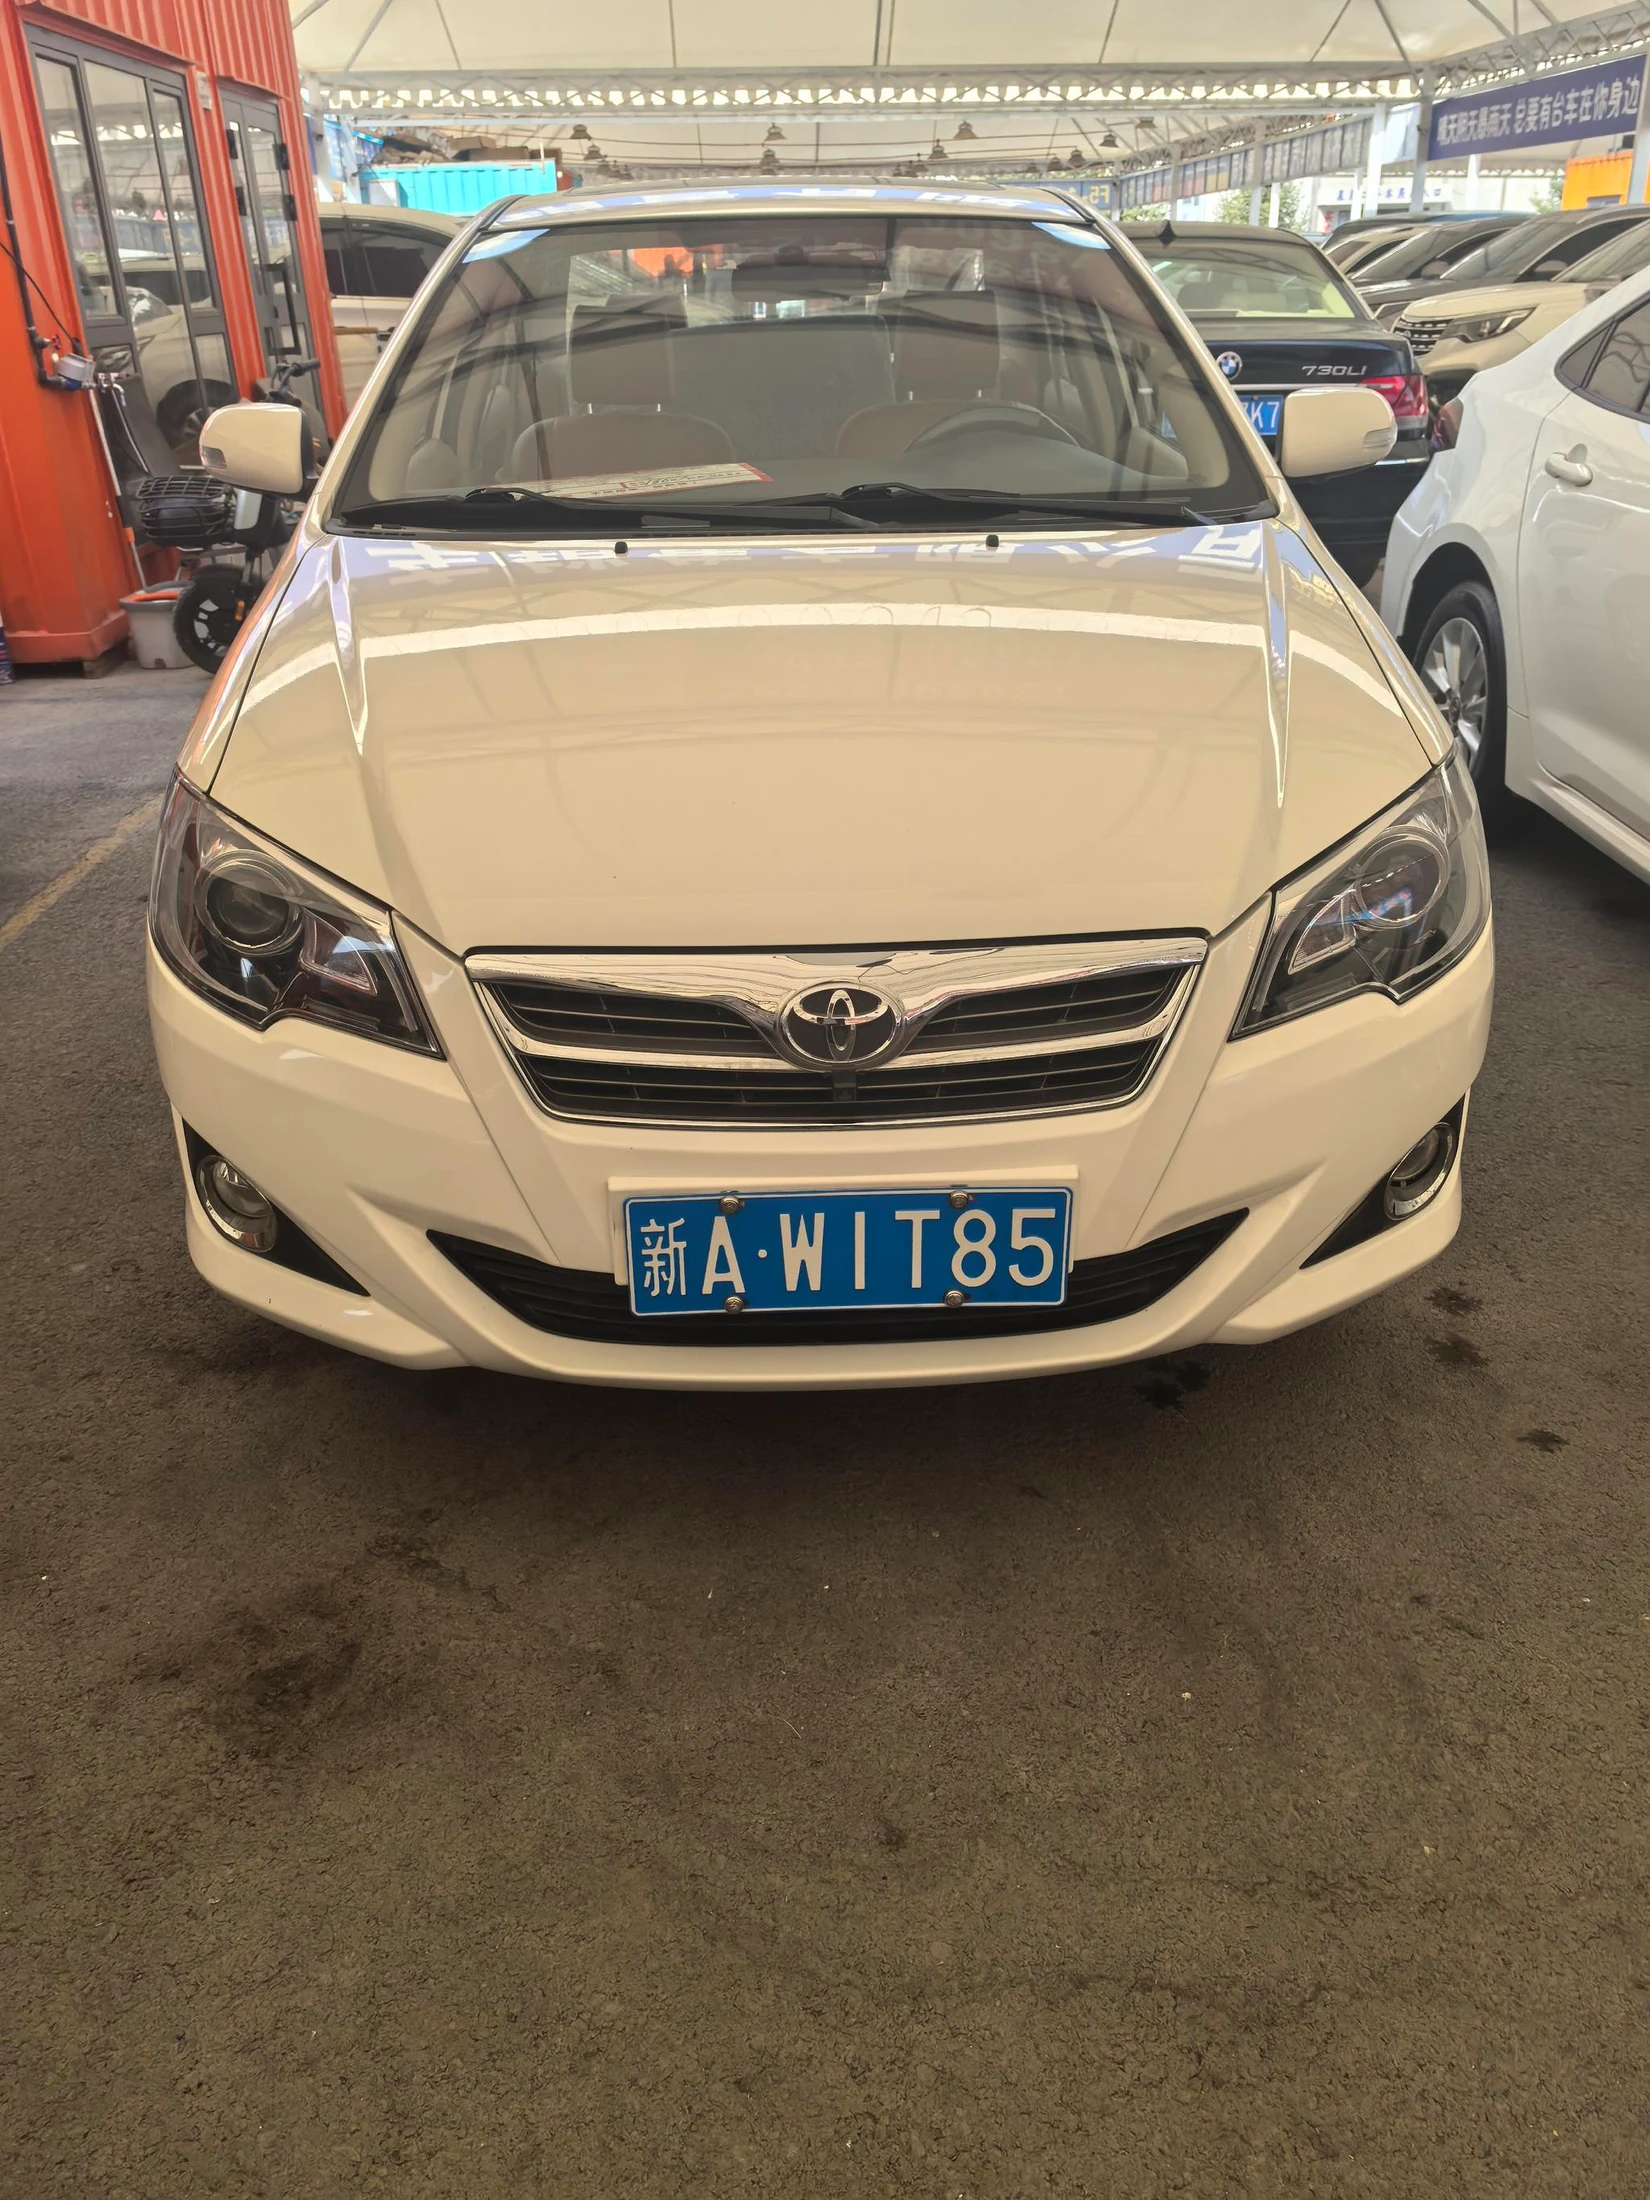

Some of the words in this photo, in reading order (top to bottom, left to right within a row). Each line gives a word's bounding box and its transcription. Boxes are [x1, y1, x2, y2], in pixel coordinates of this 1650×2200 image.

[1514, 75, 1640, 134] 总要有台车在你身边
